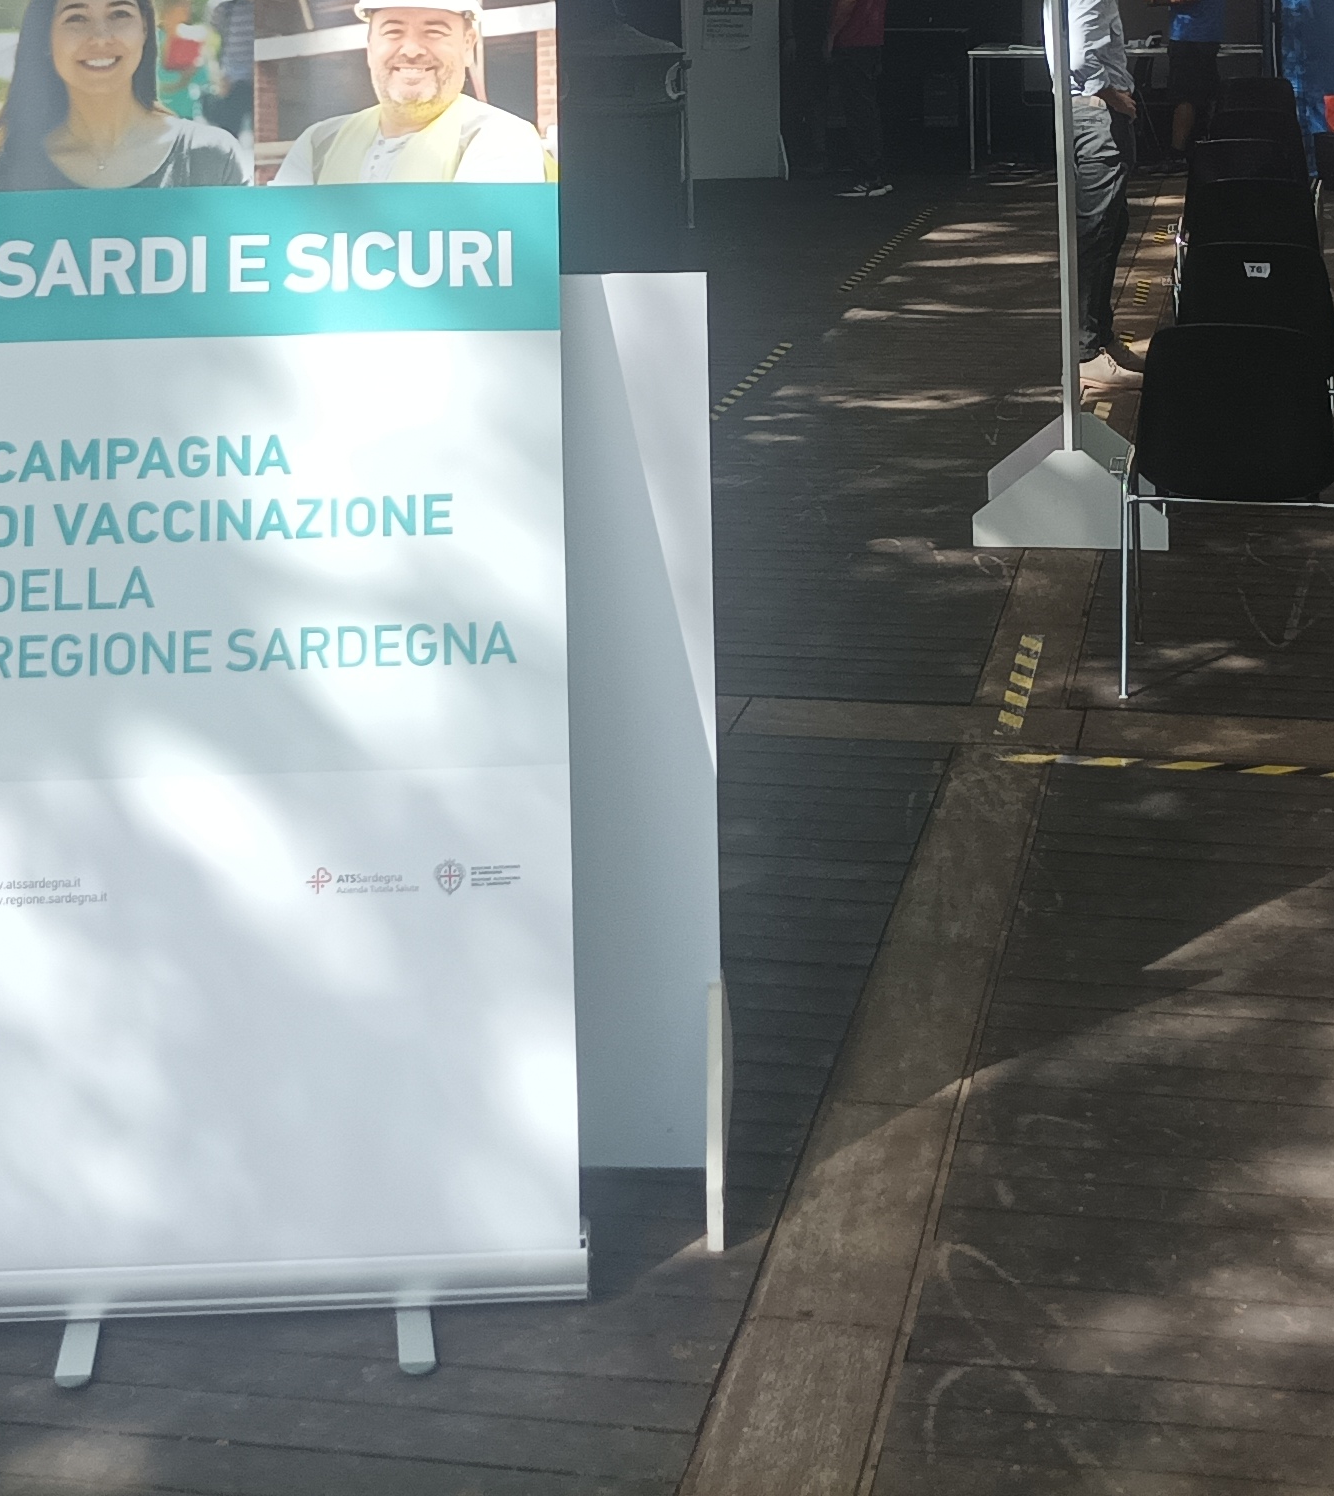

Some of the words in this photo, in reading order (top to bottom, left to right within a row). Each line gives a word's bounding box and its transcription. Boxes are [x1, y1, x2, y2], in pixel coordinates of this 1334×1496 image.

[229, 234, 270, 293] E
[283, 230, 512, 294] SICURI
[53, 493, 453, 546] VACCINAZIONE
[225, 621, 517, 673] SARDEGNA
